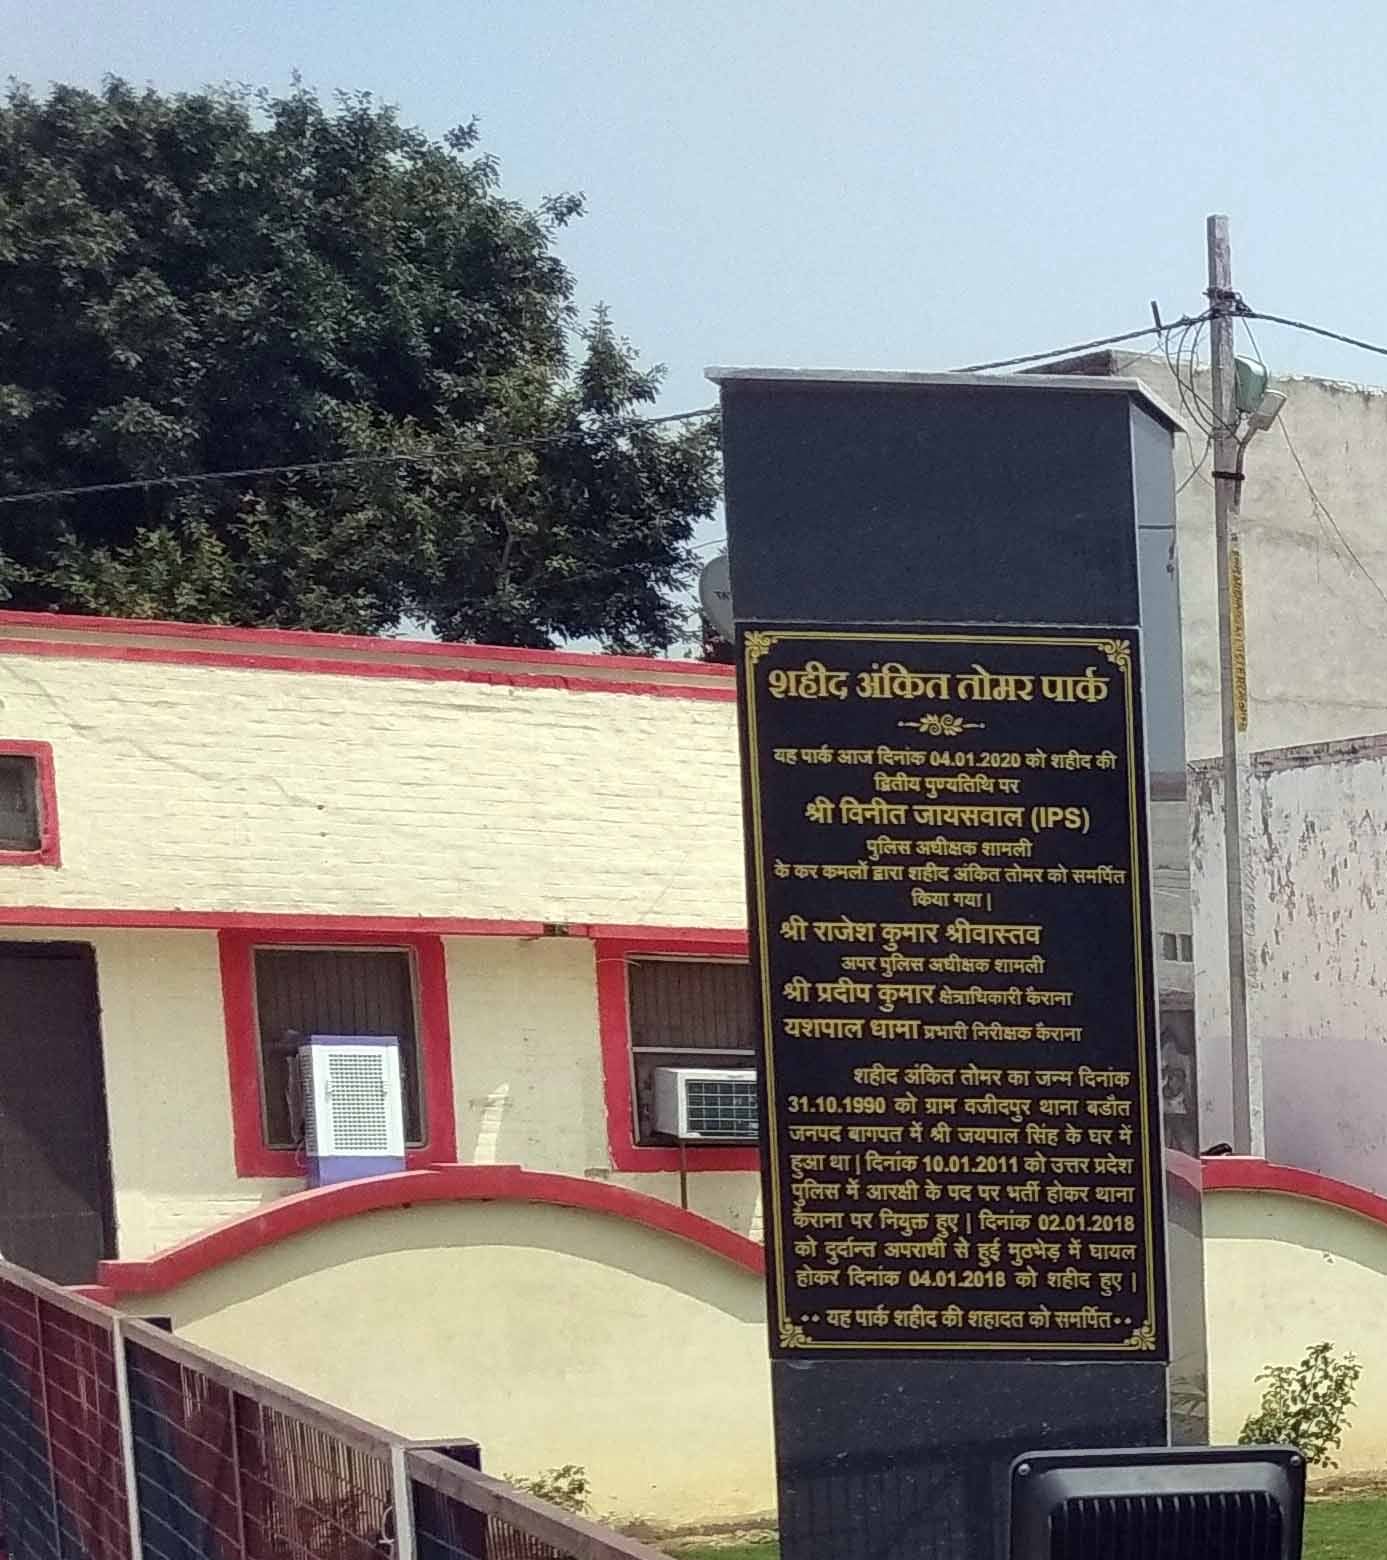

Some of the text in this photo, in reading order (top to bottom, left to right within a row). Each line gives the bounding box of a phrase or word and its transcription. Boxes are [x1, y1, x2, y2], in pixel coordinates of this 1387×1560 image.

[769, 662, 1110, 702] शहीद अंकित तोमर पार्क
[773, 744, 1117, 770] यह पार्क आज दिनांक 04.01.2020 को शहीद की
[873, 772, 1020, 798] द्वितीय पुण्यतिथि पर
[805, 796, 1089, 834] श्री विनीत जायसवाल (IPS)
[866, 835, 912, 861] पुलिस
[982, 838, 1033, 857] शामली
[774, 859, 1126, 883] के कर कमलों द्वारा शहीद अंकित तोमर को समर्पित
[911, 888, 950, 906] किया
[953, 893, 983, 907] गया
[780, 915, 1042, 951] श्री राजेश कुमार श्रीवास्तव
[842, 957, 876, 970] अपर
[880, 953, 925, 977] पुलिस
[994, 955, 1045, 973] शामली
[783, 976, 1073, 1012] श्री प्रदीप कुमार क्षेत्राधिकारी कैराना
[783, 1019, 1082, 1041] यशपाल धामा प्रभारी निरीक्षक कैराना
[854, 1063, 1131, 1087] शहीद अंकित तोमर का जन्म दिनांक
[788, 1096, 885, 1113] 31.10.1990
[894, 1091, 918, 1113] को
[925, 1098, 957, 1114] ग्राम
[964, 1094, 1032, 1122] वजीदपुर
[1040, 1100, 1079, 1115] थाना
[789, 1121, 1132, 1146] जनपद बागपत में श्री जयपाल सिंह के घर में
[790, 1155, 826, 1179] हुआ
[830, 1155, 851, 1170] था
[865, 1150, 919, 1171] दिनांक
[922, 1155, 1017, 1172] 10.01.2011
[1024, 1151, 1047, 1173] को
[1050, 1158, 1090, 1173] उत्तर
[1093, 1153, 1134, 1174] प्रदेश
[792, 1178, 1135, 1207] पुलिस में आरक्षी के पद पर भर्ती होकर थाना
[792, 1204, 844, 1228] कैराना
[850, 1213, 873, 1228] पर
[879, 1208, 929, 1236] नियुक्त
[935, 1214, 959, 1238] हुए
[978, 1209, 1032, 1230] दिनांक
[1038, 1214, 1134, 1231] 02.01.2018
[794, 1235, 818, 1257] को
[953, 1237, 970, 1258] से
[977, 1238, 1001, 1267] हुई
[1068, 1238, 1082, 1259] में
[1089, 1244, 1136, 1260] घायल
[795, 1264, 840, 1287] होकर
[847, 1265, 901, 1286] दिनांक
[909, 1270, 1006, 1287] 04.01.2018
[1014, 1265, 1038, 1287] को
[1048, 1267, 1092, 1289] शहीद
[1099, 1273, 1122, 1296] हुए
[826, 1304, 1112, 1329] यह पार्क शहीद की शहादत को समर्पित
